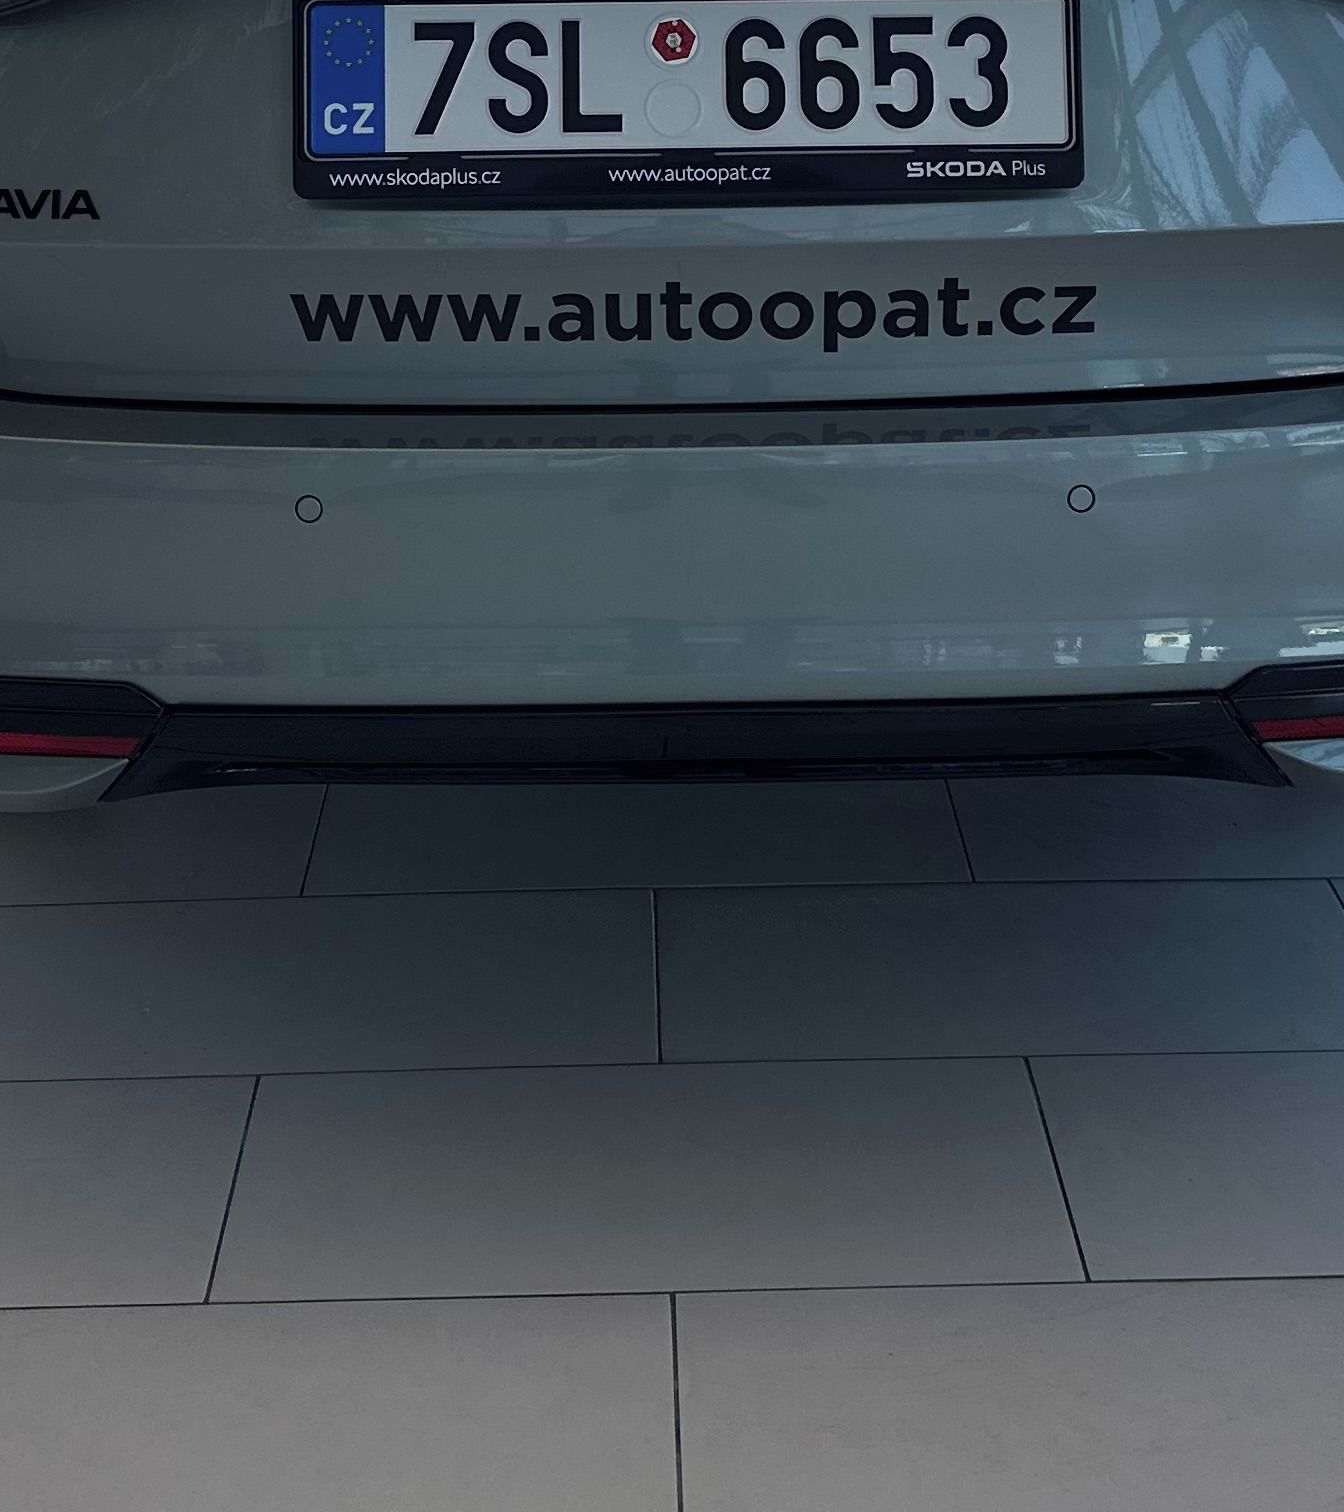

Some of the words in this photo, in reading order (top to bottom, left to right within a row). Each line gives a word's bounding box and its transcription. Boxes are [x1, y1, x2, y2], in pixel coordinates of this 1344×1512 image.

[413, 19, 624, 135] 7SL
[724, 15, 1009, 131] 6653
[323, 102, 375, 135] CZ
[329, 168, 502, 189] www.skodaplus.cz
[608, 164, 772, 185] www.autoopat.cz
[906, 160, 1007, 178] SKODA
[1012, 159, 1047, 177] Plus
[290, 276, 1097, 353] www.autoopat.cz
